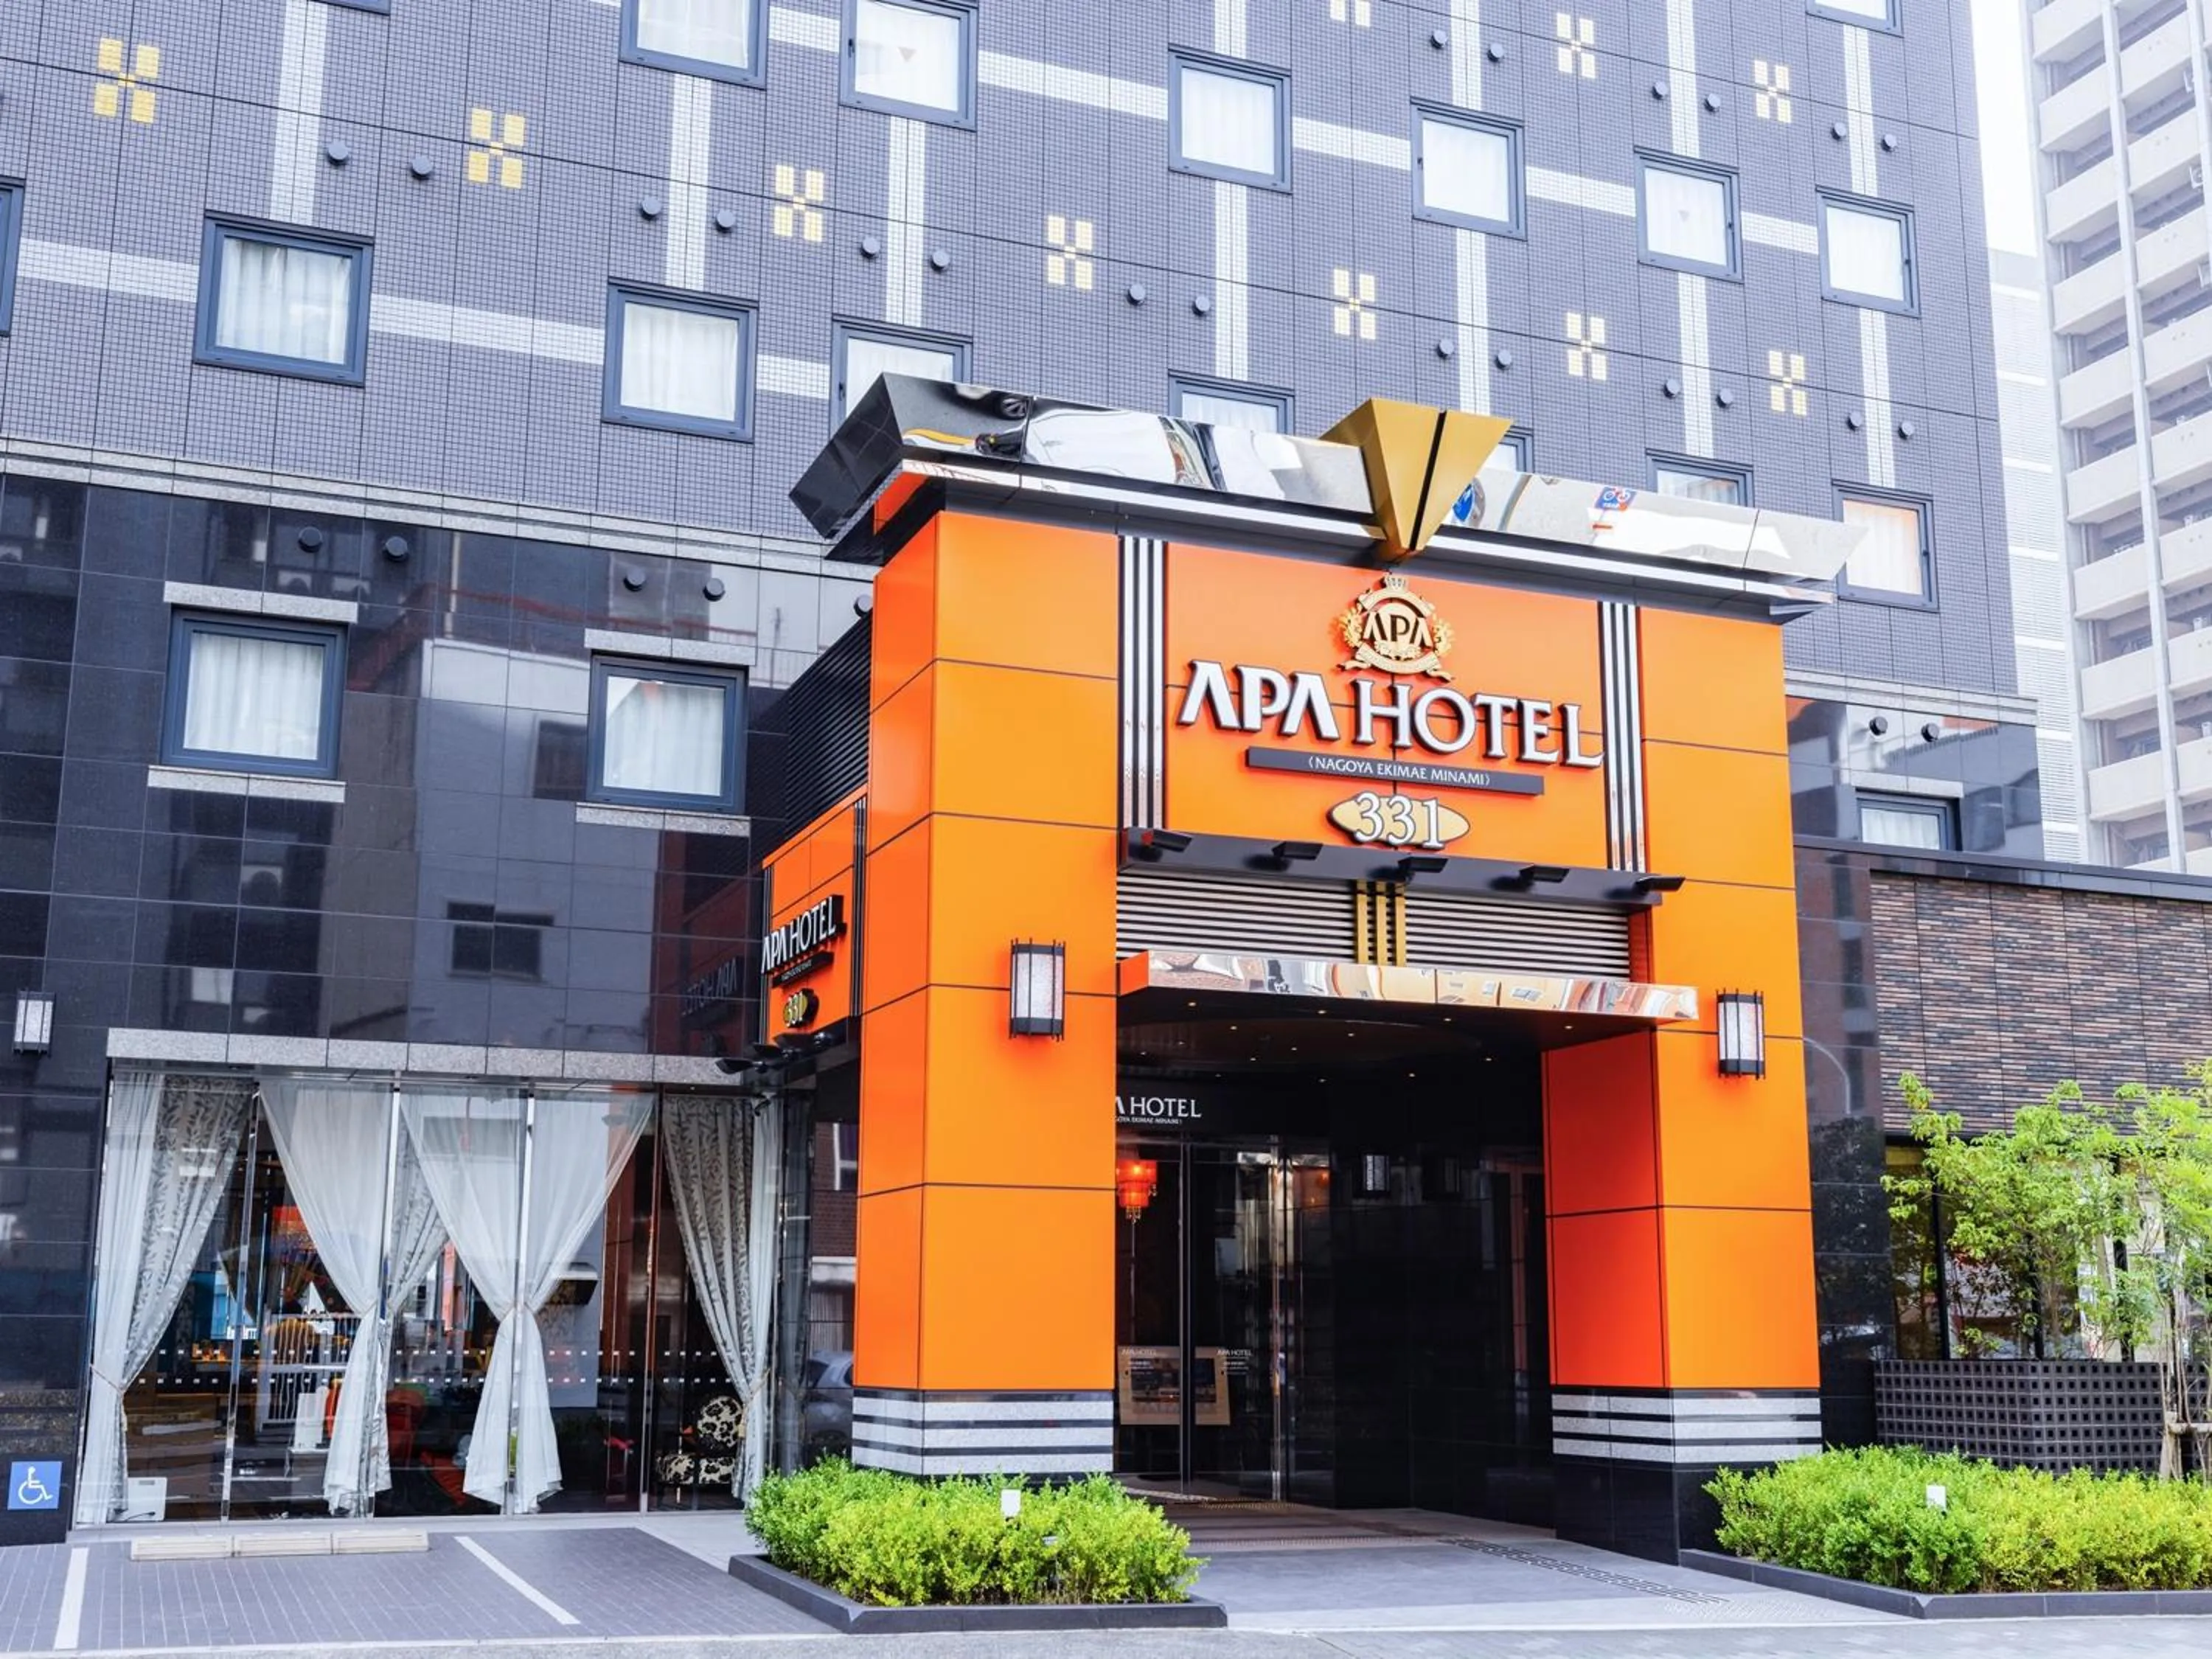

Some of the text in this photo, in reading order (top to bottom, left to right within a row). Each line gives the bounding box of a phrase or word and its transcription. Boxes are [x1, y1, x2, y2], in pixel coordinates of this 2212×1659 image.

[1363, 612, 1435, 649] APA
[1179, 660, 1604, 768] APA HOTEL
[1377, 762, 1428, 779] EKIMAE
[1354, 791, 1445, 849] 331
[761, 896, 836, 974] APA HOTEL
[1130, 1096, 1203, 1118] HOTEL
